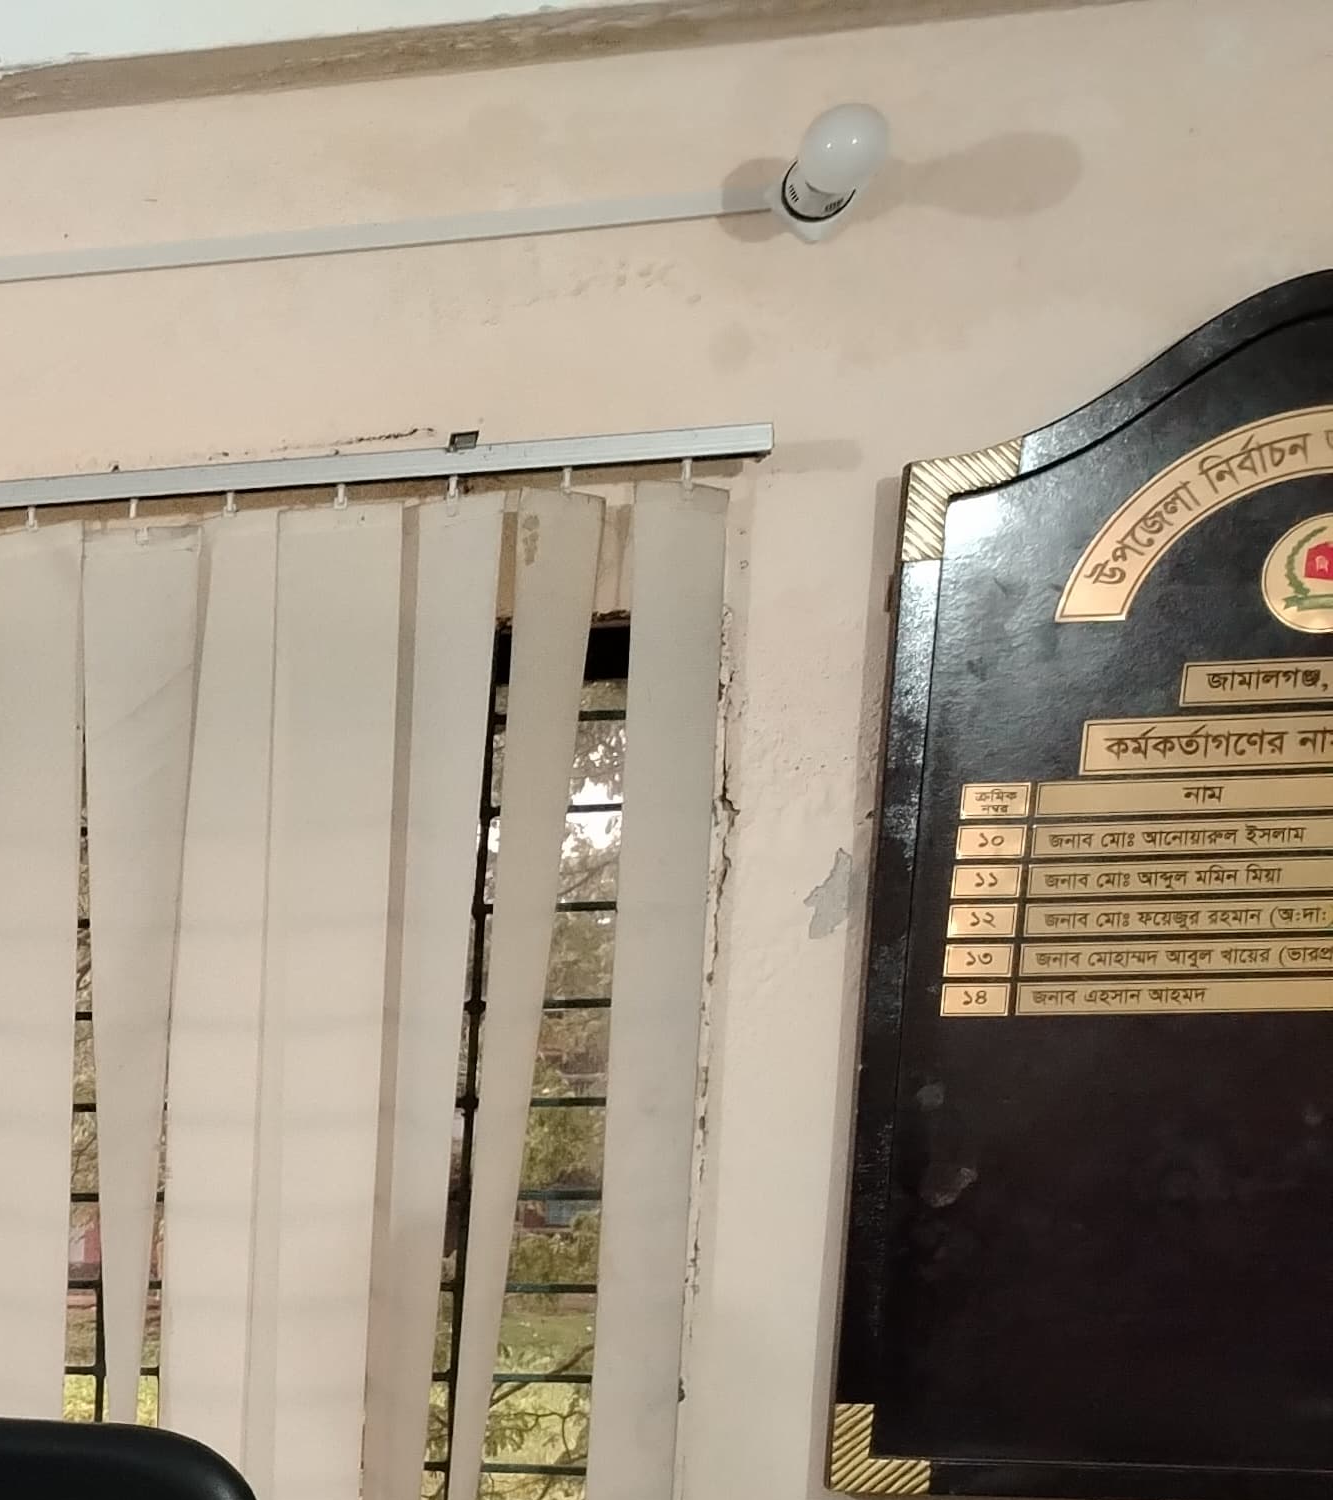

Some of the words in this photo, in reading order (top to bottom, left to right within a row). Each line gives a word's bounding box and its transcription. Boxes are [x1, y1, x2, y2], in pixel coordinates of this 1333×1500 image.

[1084, 480, 1202, 585] উপজেলা
[1198, 433, 1312, 494] নির্বাচন
[1206, 667, 1329, 692] জামালগঞ্জ,
[1104, 724, 1289, 761] কর্মকর্তাগণের
[1297, 727, 1333, 753] না
[1182, 785, 1224, 804] নাম
[978, 832, 1005, 848] ১০
[1048, 832, 1094, 848] জনাব
[1141, 829, 1238, 847] আনোয়ারুল
[1245, 824, 1307, 845] ইসলাম
[974, 871, 999, 888] ১১
[1044, 873, 1091, 889] জনাব
[1137, 869, 1189, 889] আব্দুল
[1195, 864, 1239, 885] মমিন
[1245, 863, 1282, 884] মিয়া
[969, 911, 996, 928] ১২
[1044, 912, 1090, 928] জনাব
[1208, 908, 1263, 927] রহমান
[965, 951, 993, 966] ১৩
[1035, 951, 1082, 967] জনাব
[1087, 949, 1159, 967] মোহাম্মদ
[1165, 947, 1215, 968] আবুল
[1278, 945, 1333, 966] (ভারপ্র
[962, 990, 988, 1006] ১৪
[1031, 989, 1077, 1006] জনাব
[1084, 988, 1141, 1006] এহসান
[1148, 986, 1208, 1004] আহমদ
